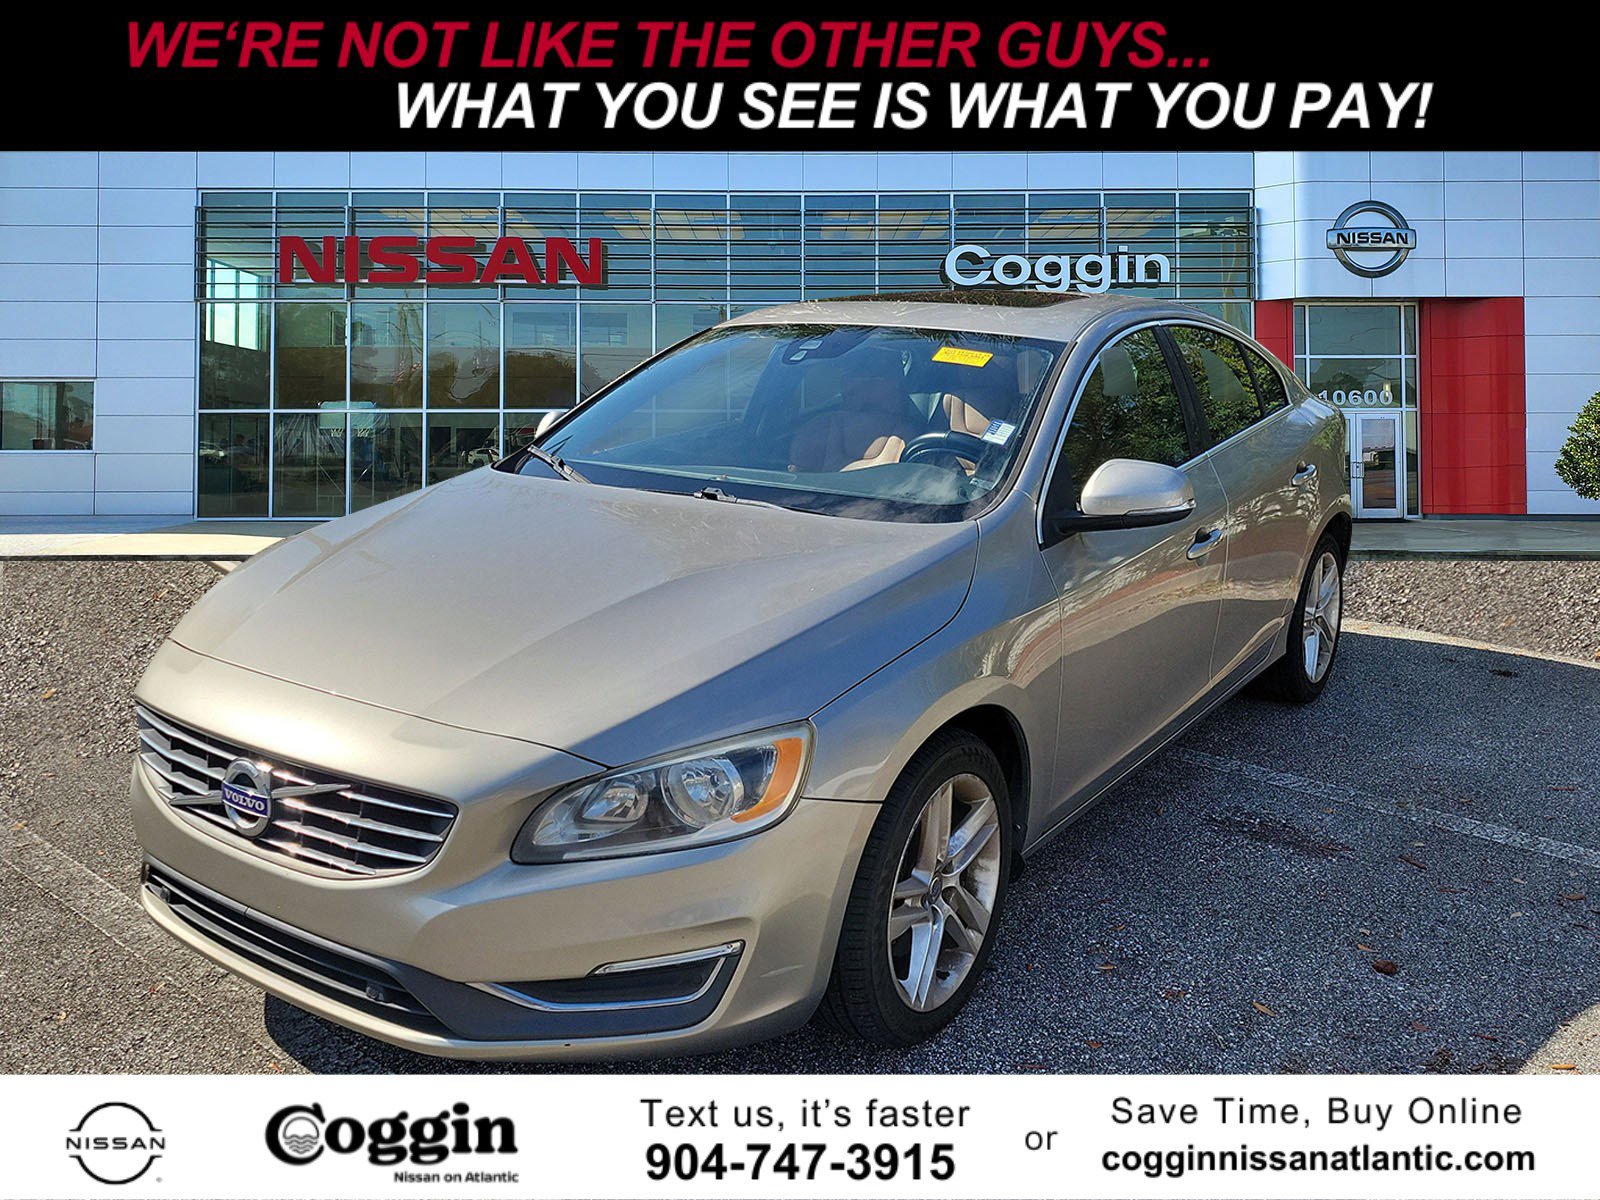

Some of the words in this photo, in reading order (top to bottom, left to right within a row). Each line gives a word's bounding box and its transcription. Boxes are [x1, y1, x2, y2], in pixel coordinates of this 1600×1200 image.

[1336, 231, 1408, 244] NISSAN
[279, 236, 602, 284] NISSAN
[945, 244, 1171, 294] Coggin
[1317, 389, 1393, 406] 10600
[223, 787, 266, 811] VOLVO
